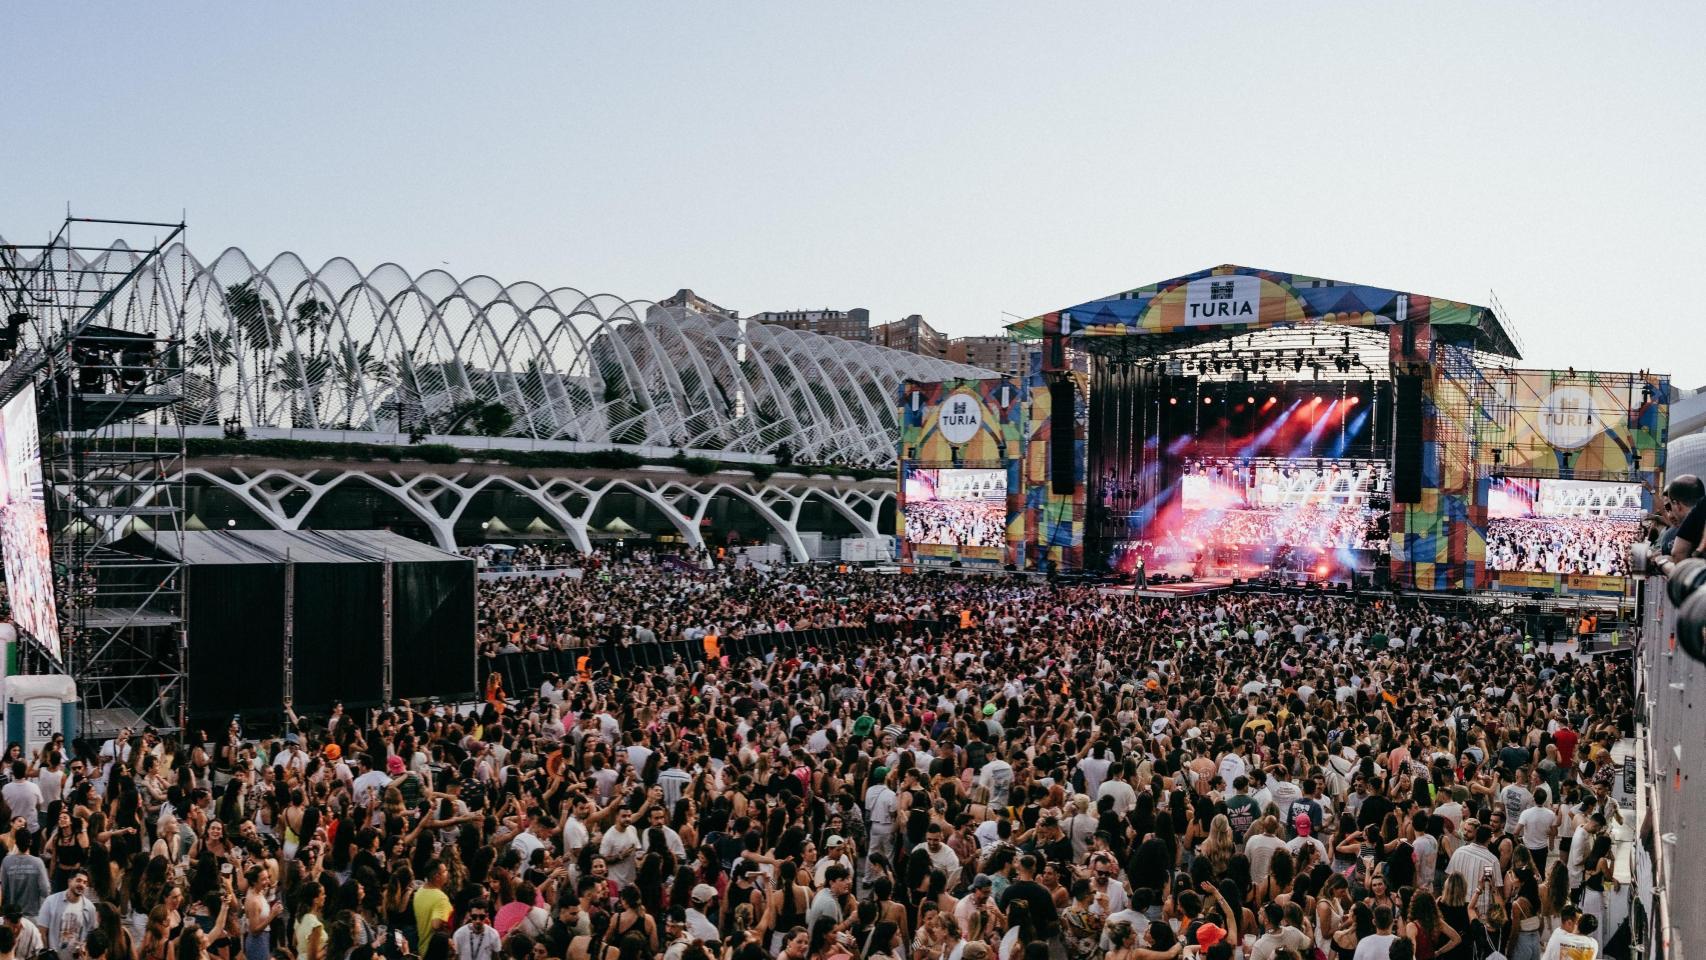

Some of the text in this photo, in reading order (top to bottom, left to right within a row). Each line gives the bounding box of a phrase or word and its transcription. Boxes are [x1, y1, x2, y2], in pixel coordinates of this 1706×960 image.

[1190, 301, 1253, 318] TURIA
[943, 416, 977, 425] TURIA
[1543, 414, 1594, 427] TURIA
